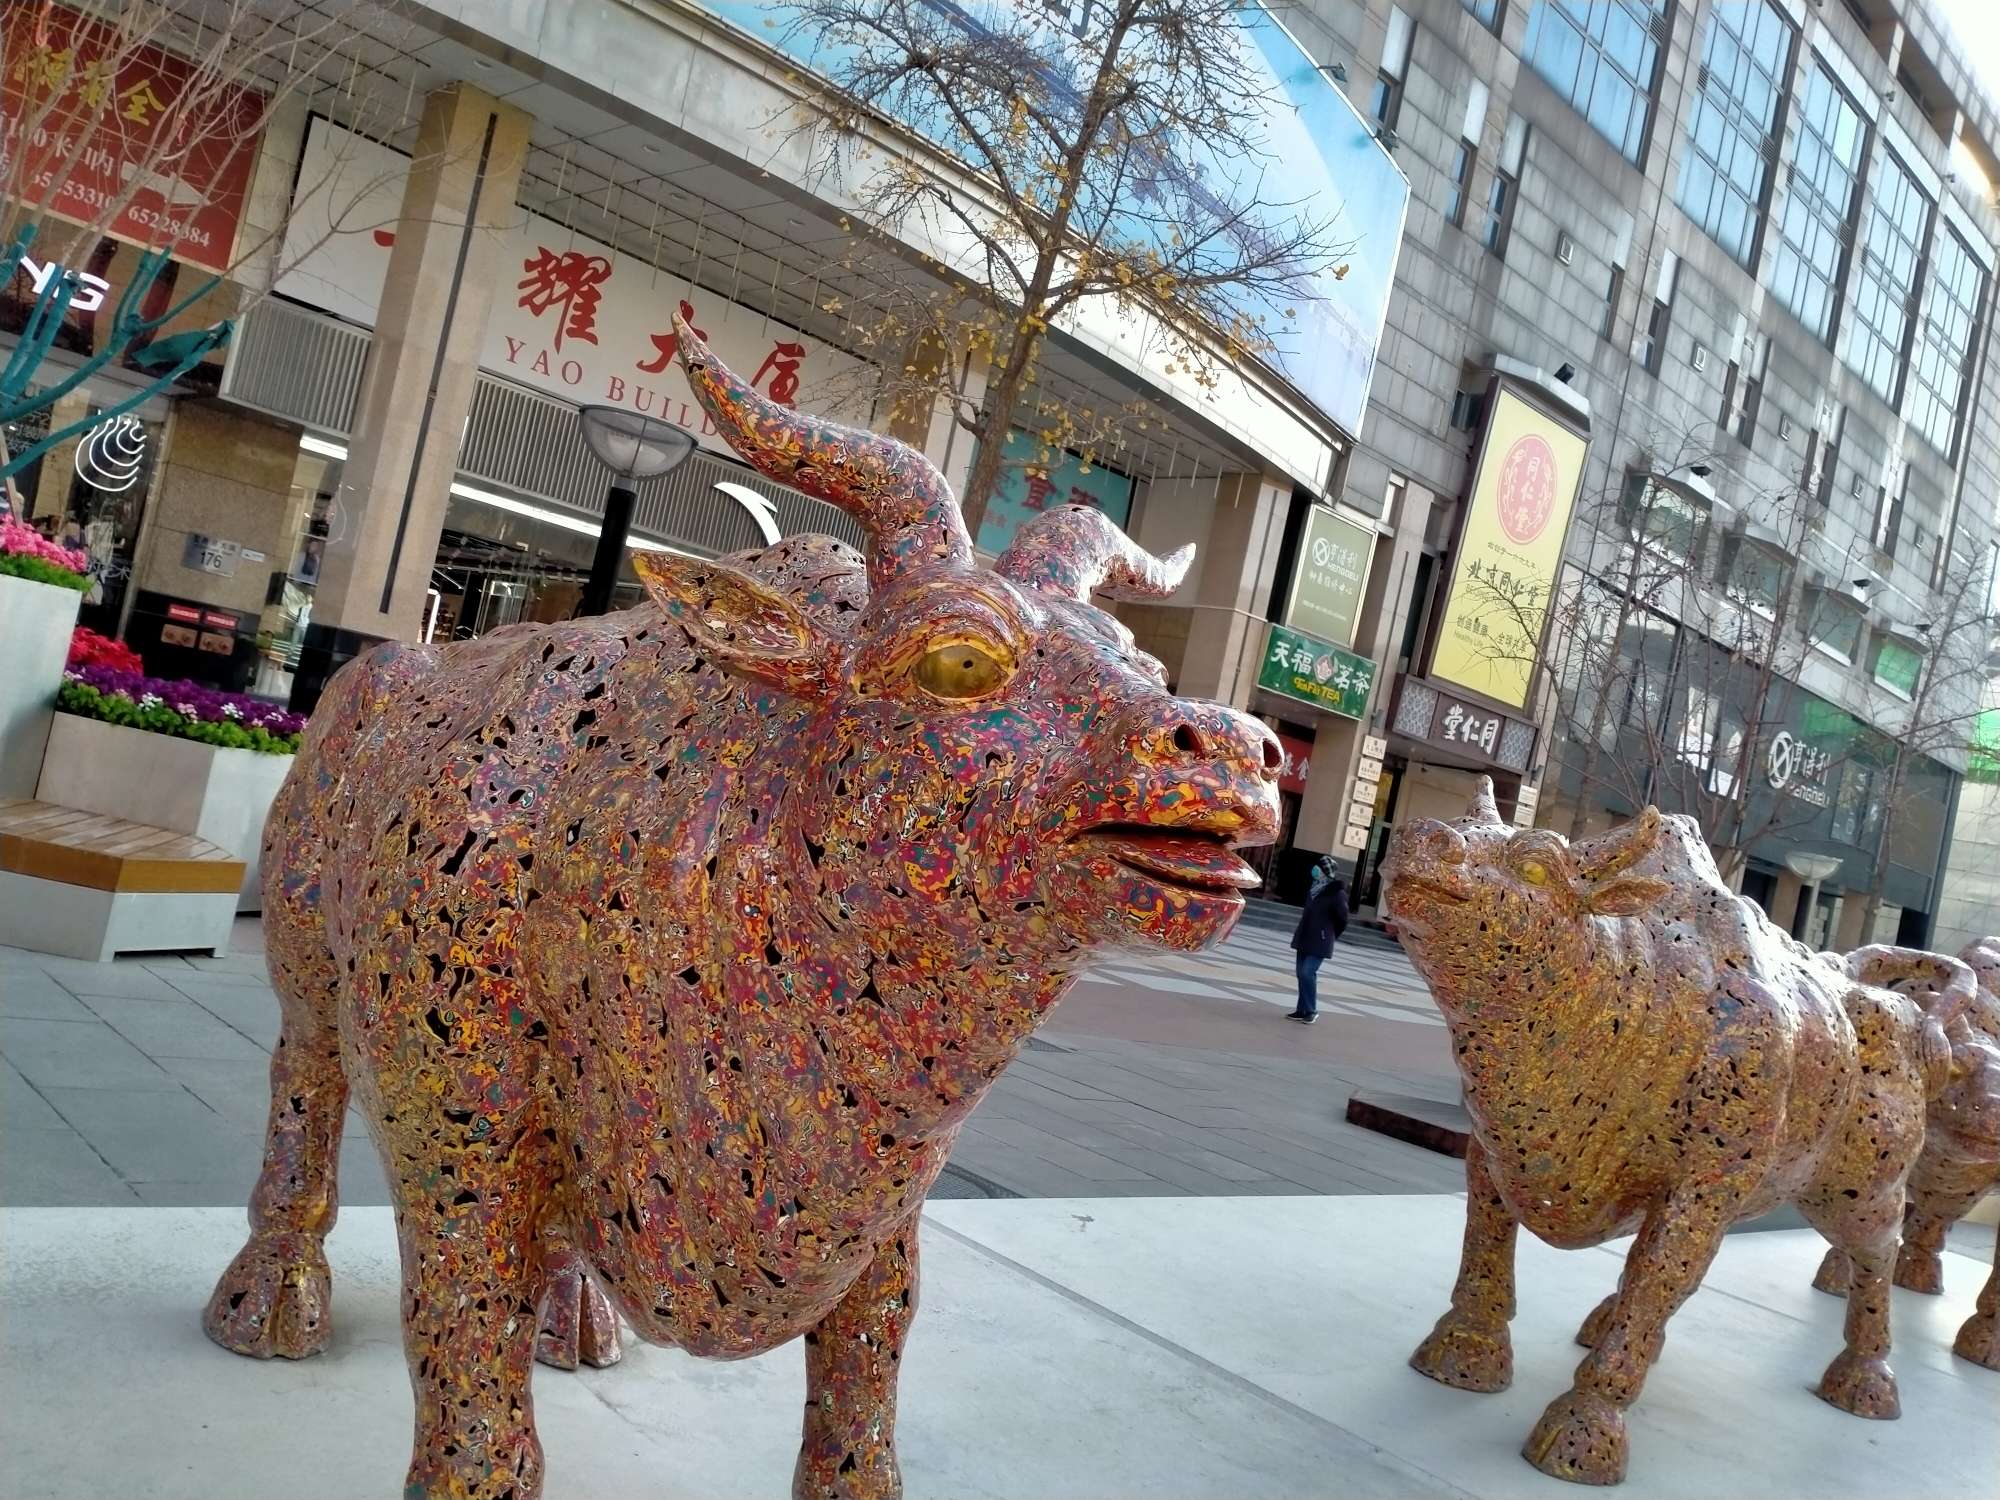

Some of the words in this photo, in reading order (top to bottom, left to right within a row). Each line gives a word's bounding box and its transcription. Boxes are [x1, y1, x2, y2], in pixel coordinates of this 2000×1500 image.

[504, 335, 583, 385] YAO
[200, 551, 222, 568] 176
[1271, 641, 1371, 695] 天福茗茶
